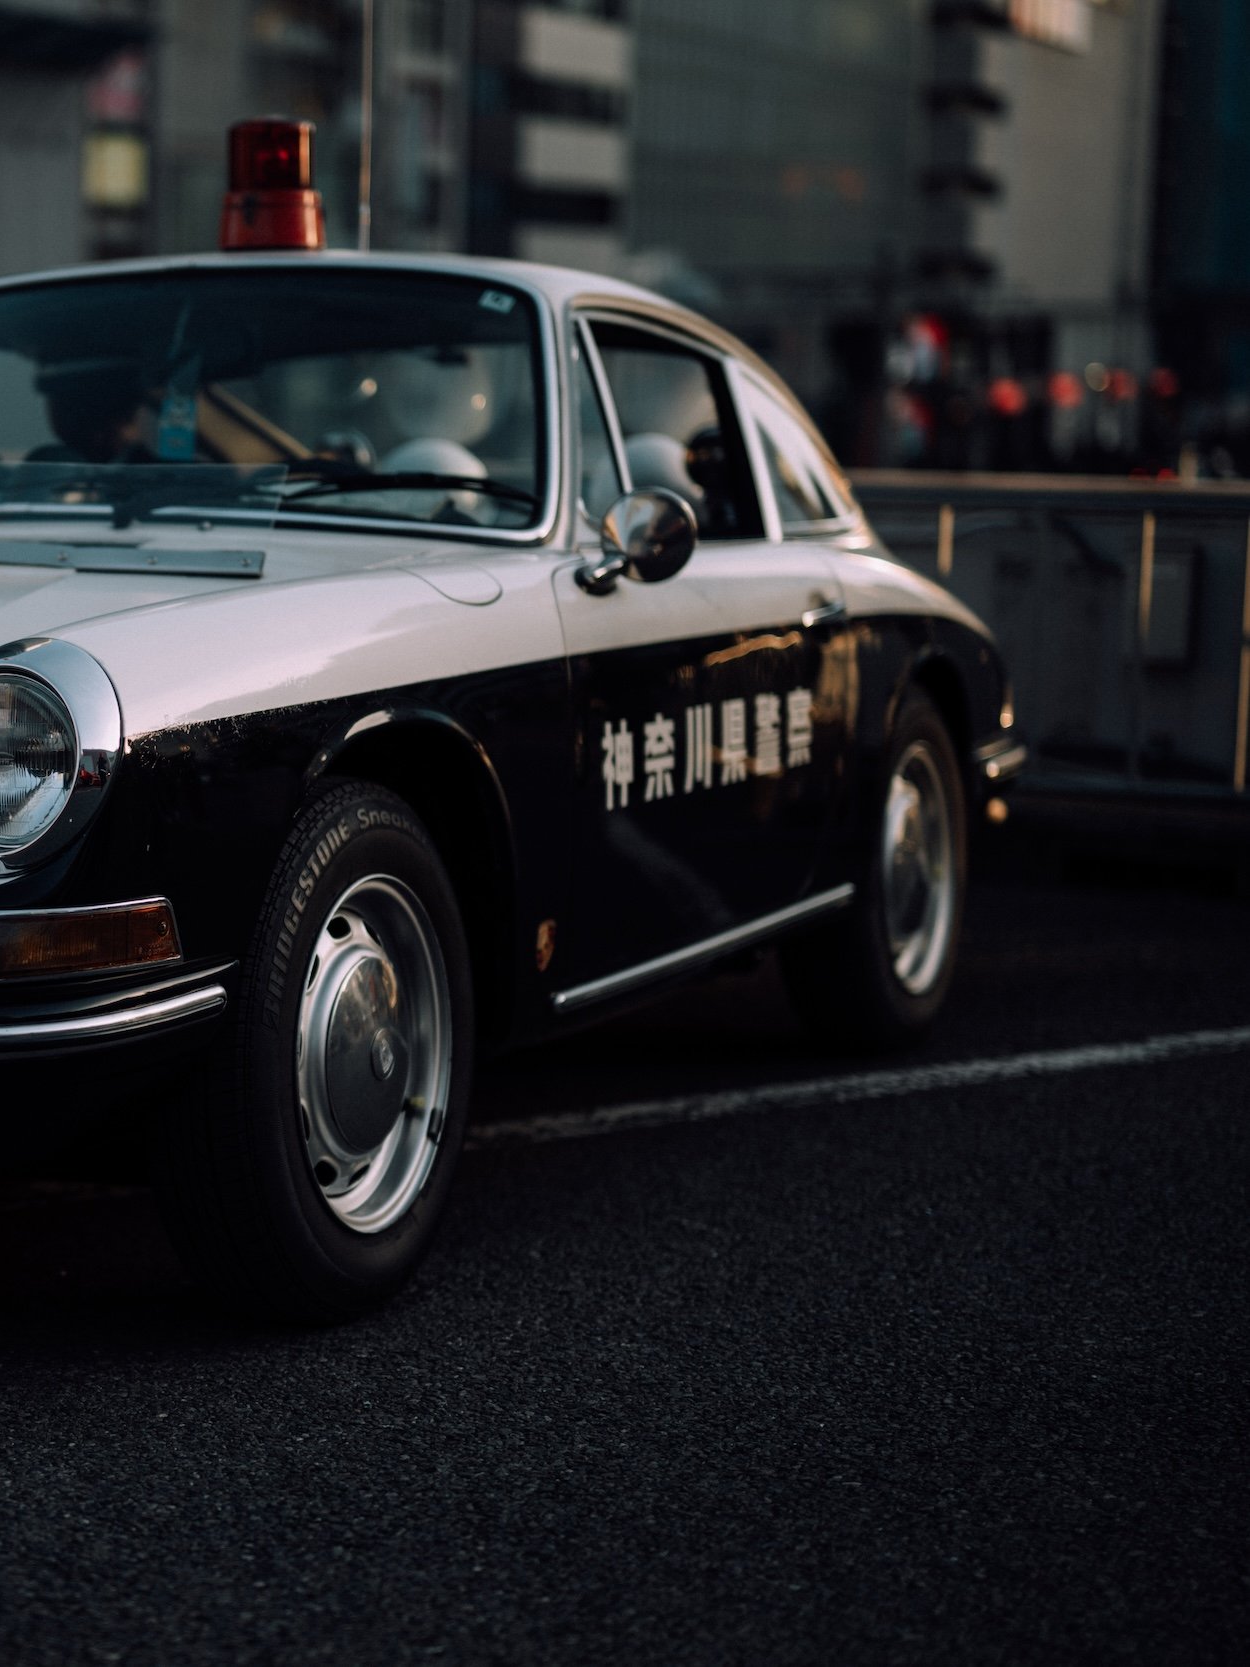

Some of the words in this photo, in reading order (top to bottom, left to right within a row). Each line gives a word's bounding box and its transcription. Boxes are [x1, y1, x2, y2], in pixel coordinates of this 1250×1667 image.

[602, 687, 812, 811] 神奈川県警察
